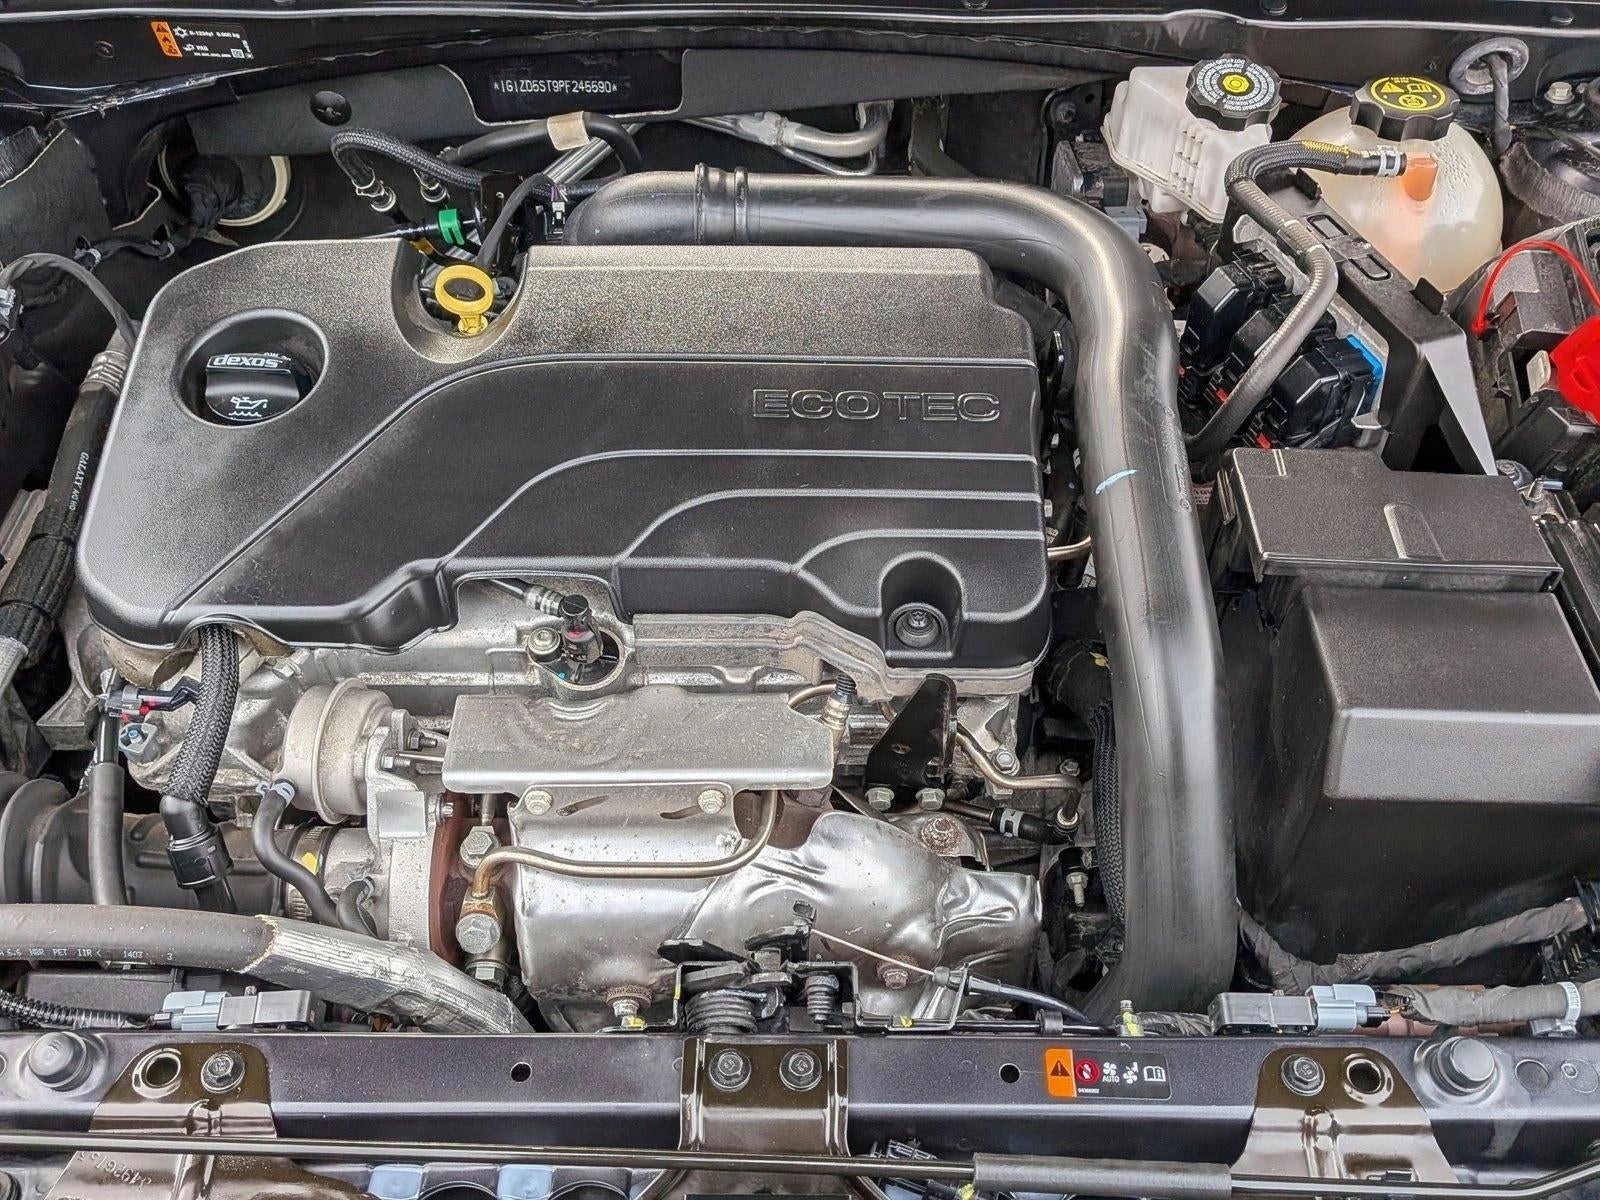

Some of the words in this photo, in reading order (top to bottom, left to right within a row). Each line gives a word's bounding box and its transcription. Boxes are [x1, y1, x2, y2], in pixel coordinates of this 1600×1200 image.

[213, 354, 279, 368] dexos
[753, 389, 1000, 422] ECOTEC
[74, 452, 89, 490] GALAXY
[53, 948, 68, 957] PET
[123, 950, 144, 959] 1403
[1102, 1075, 1120, 1083] AUTO
